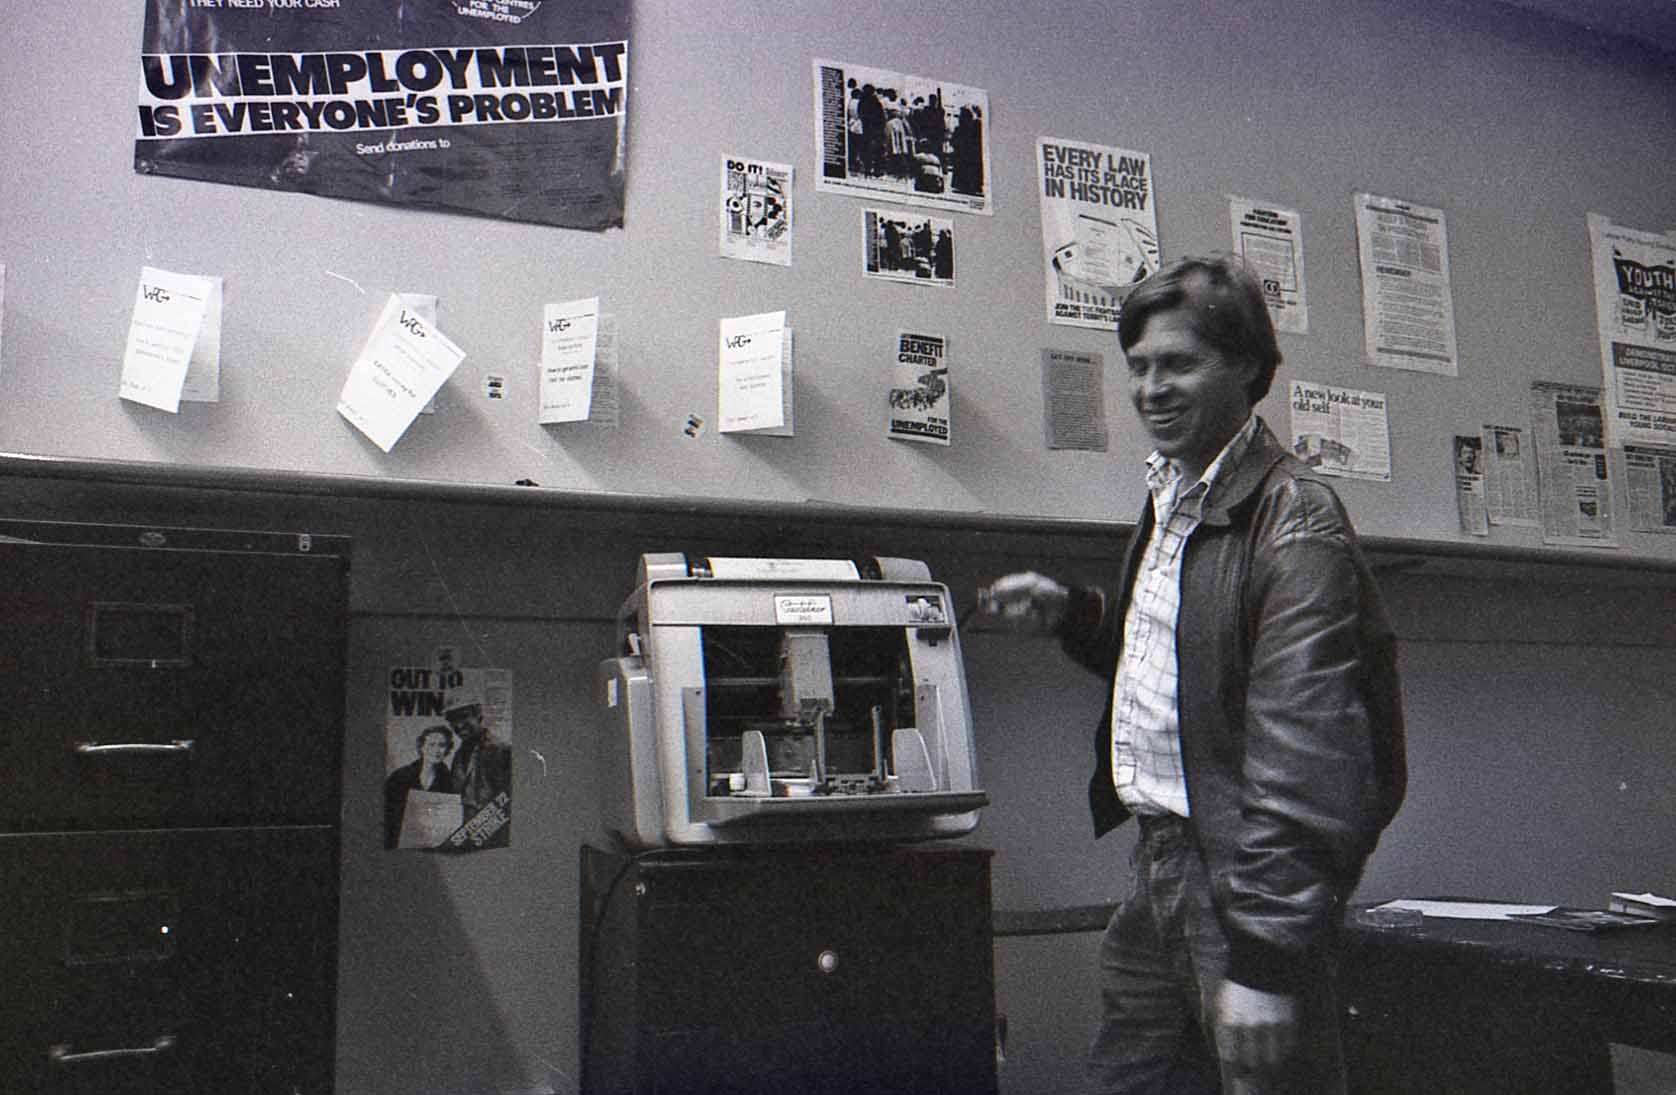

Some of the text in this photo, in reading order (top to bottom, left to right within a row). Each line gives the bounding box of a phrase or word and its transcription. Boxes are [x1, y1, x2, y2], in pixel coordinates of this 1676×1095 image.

[191, 0, 341, 8] THEY NEED YOUR CASH
[142, 42, 626, 99] UNEMPLOYMENT
[138, 86, 625, 137] IS EVERYONE'S PROBLEM
[356, 138, 450, 156] Send donations to
[727, 160, 744, 172] DO
[1043, 143, 1145, 177] EVERY LAW
[1044, 163, 1148, 193] HAS ITS PLACE
[1045, 177, 1148, 211] IN HISTORY
[1622, 265, 1674, 289] YOUTH
[900, 339, 944, 358] BENEFIT
[898, 353, 937, 367] CHARTER
[1293, 399, 1330, 415] old self
[1294, 385, 1384, 410] A new look at your
[891, 419, 948, 435] UNEMPLOYED
[391, 669, 432, 689] OUT
[391, 691, 445, 717] WIN
